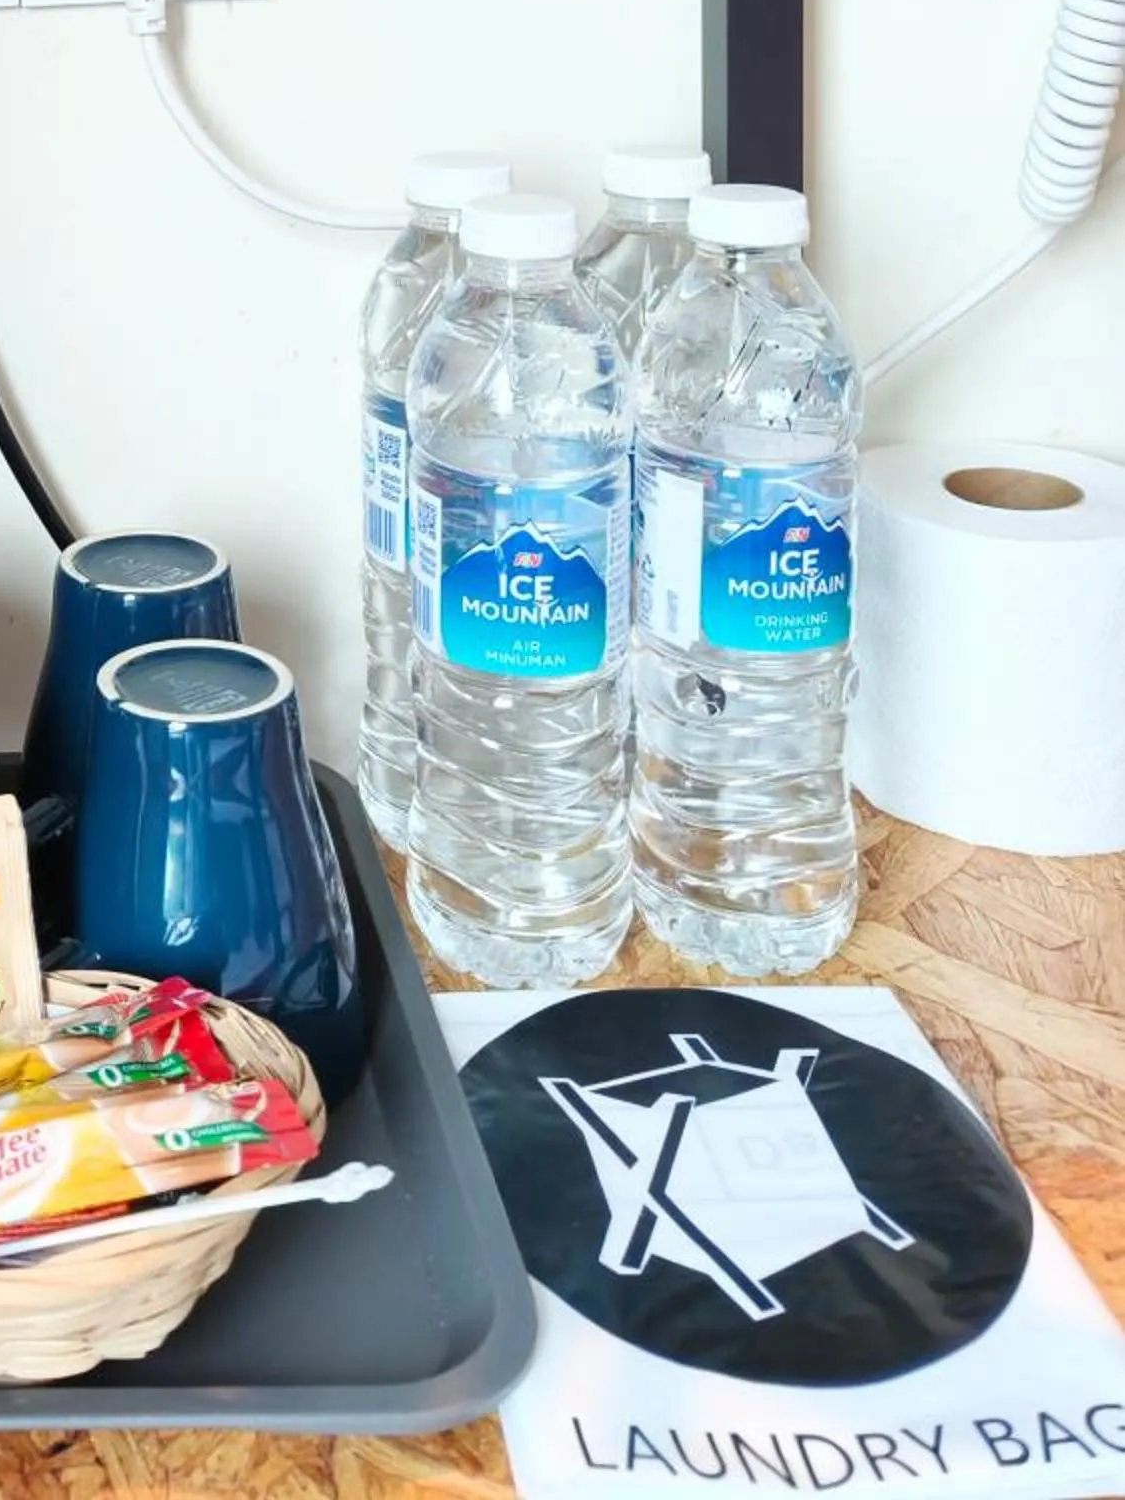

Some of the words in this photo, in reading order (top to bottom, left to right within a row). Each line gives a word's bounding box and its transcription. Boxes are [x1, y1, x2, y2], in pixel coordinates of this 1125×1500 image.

[769, 548, 820, 577] ICE
[498, 571, 555, 601] ICE
[728, 572, 845, 602] MOUNTAIN
[461, 595, 590, 628] MOUNTAIN
[754, 612, 828, 628] DRINKING
[512, 639, 541, 653] AIR
[765, 627, 821, 642] WATER
[484, 650, 567, 667] MINUMAN
[572, 1416, 949, 1490] LAUNDRY
[973, 1403, 1125, 1467] BAG
